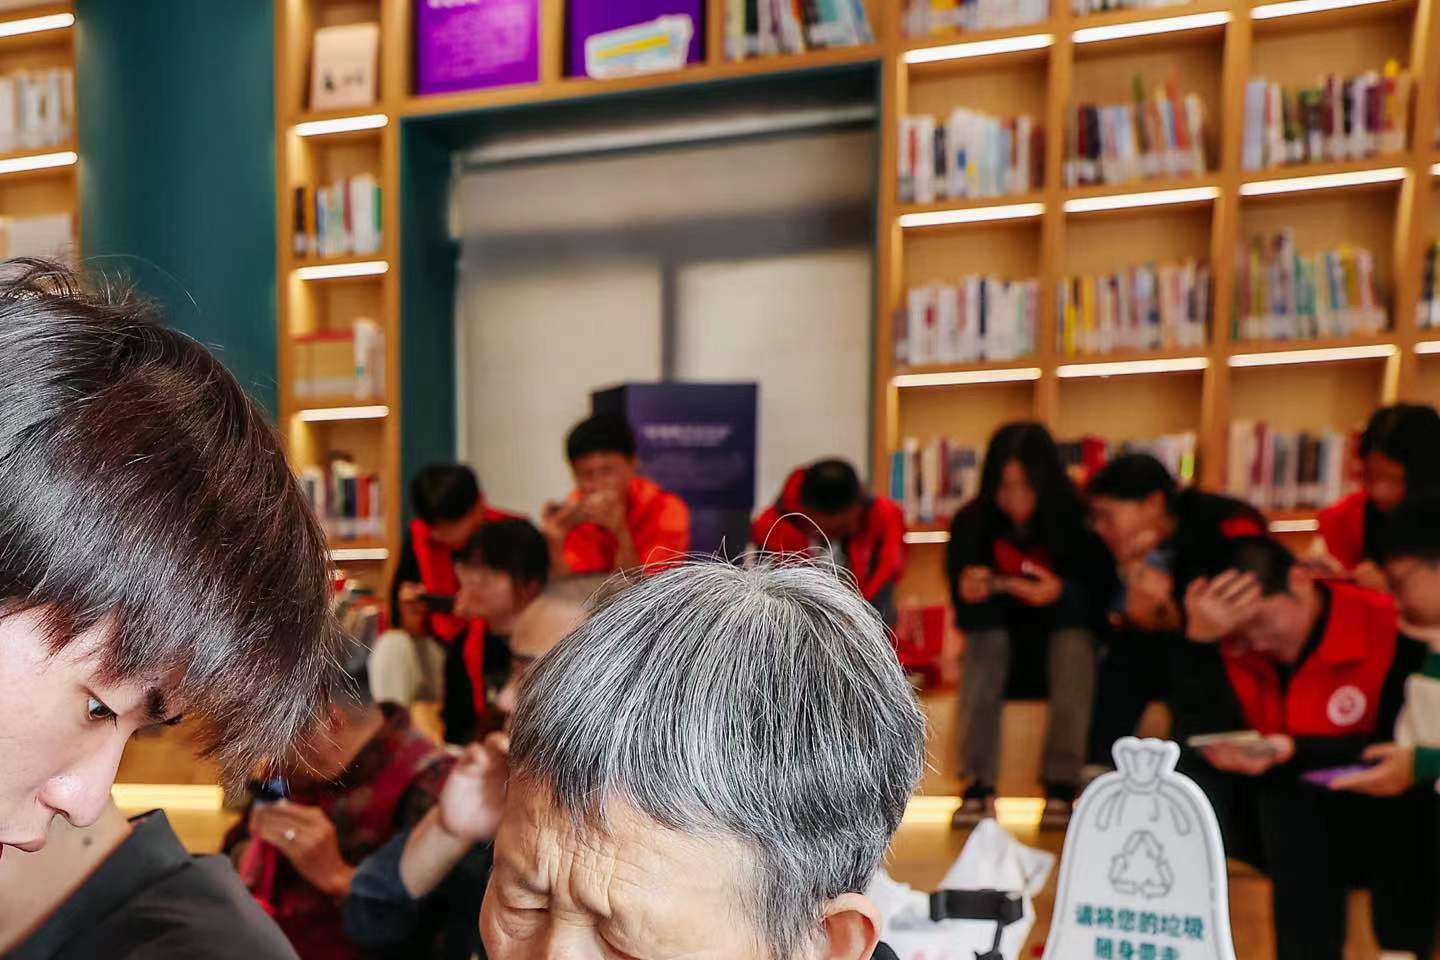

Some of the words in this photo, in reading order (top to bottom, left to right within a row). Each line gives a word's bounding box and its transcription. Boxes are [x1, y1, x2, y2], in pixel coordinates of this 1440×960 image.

[1076, 904, 1204, 940] 请将您的垃圾
